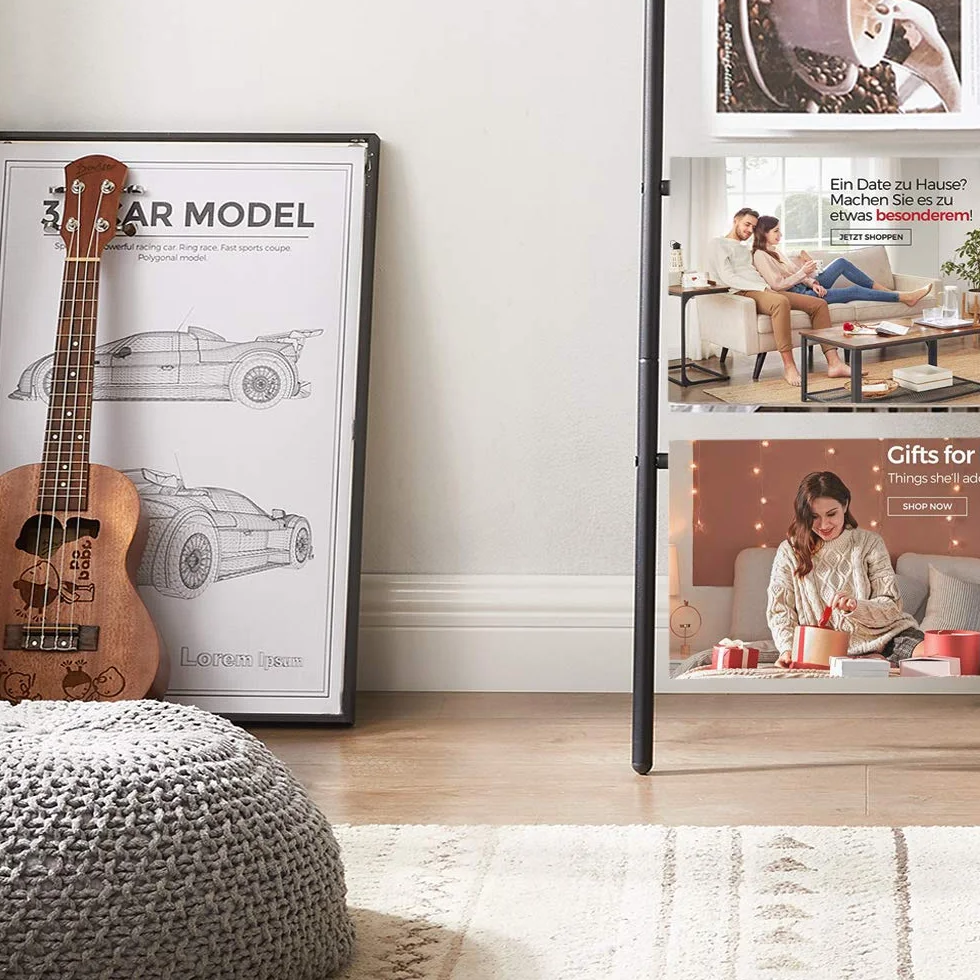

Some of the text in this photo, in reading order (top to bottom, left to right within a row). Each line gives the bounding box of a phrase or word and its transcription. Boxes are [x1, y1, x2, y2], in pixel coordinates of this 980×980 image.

[829, 178, 968, 191] Ein Date zu Hause?
[829, 194, 953, 206] Machen Sie es zu
[42, 200, 61, 227] 3
[186, 201, 315, 228] MODEL
[829, 208, 973, 222] etwas besonderem!
[838, 233, 904, 242] JETZT SHOPPEN
[103, 242, 135, 252] owerful
[135, 243, 162, 254] racing
[179, 243, 199, 254] Ring
[220, 243, 238, 252] Fast
[238, 244, 264, 254] sports
[138, 253, 178, 264] Polygonal
[887, 444, 939, 465] Gifts
[943, 444, 976, 465] for
[887, 472, 928, 486] Things
[930, 472, 960, 484] she'll
[902, 502, 953, 511] SHOP NOW
[180, 646, 304, 671] Lorem Ipsum
